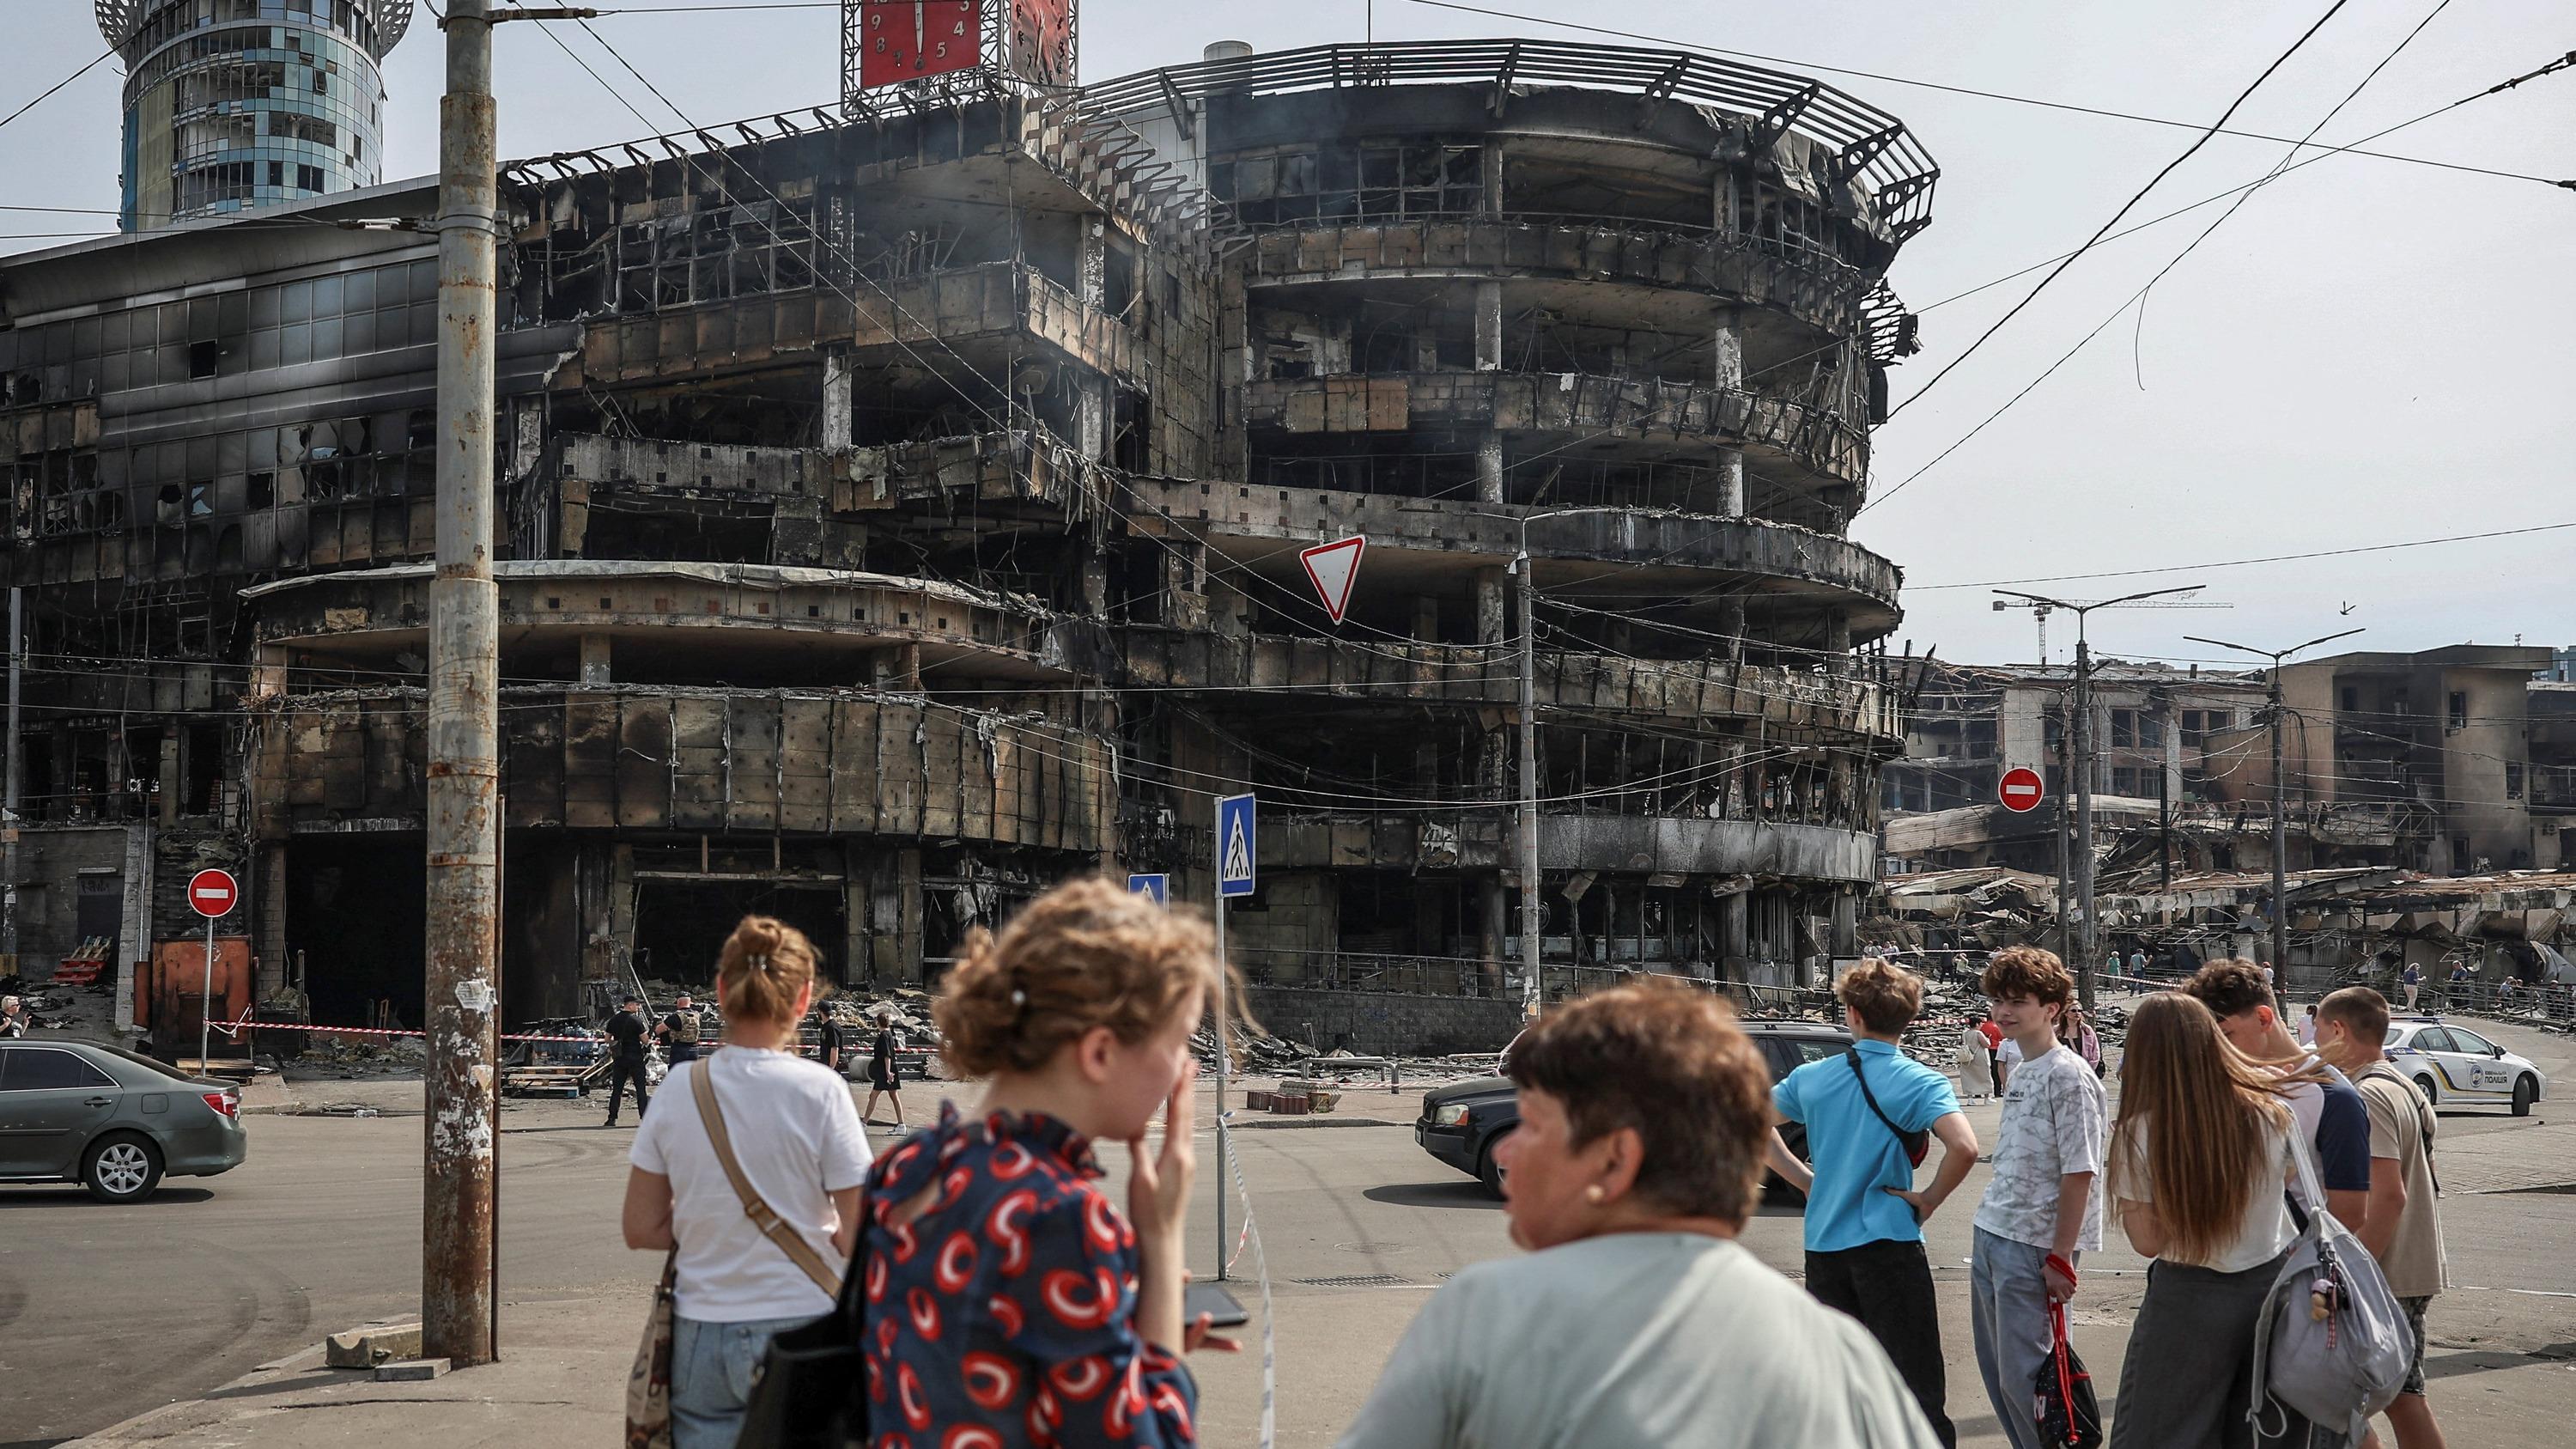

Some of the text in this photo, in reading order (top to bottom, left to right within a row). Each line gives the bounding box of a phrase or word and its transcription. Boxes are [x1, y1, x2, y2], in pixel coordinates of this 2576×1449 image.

[872, 14, 881, 30] 9
[953, 21, 964, 36] 4
[877, 37, 885, 52] 8
[936, 41, 946, 58] 5
[914, 54, 925, 70] 6
